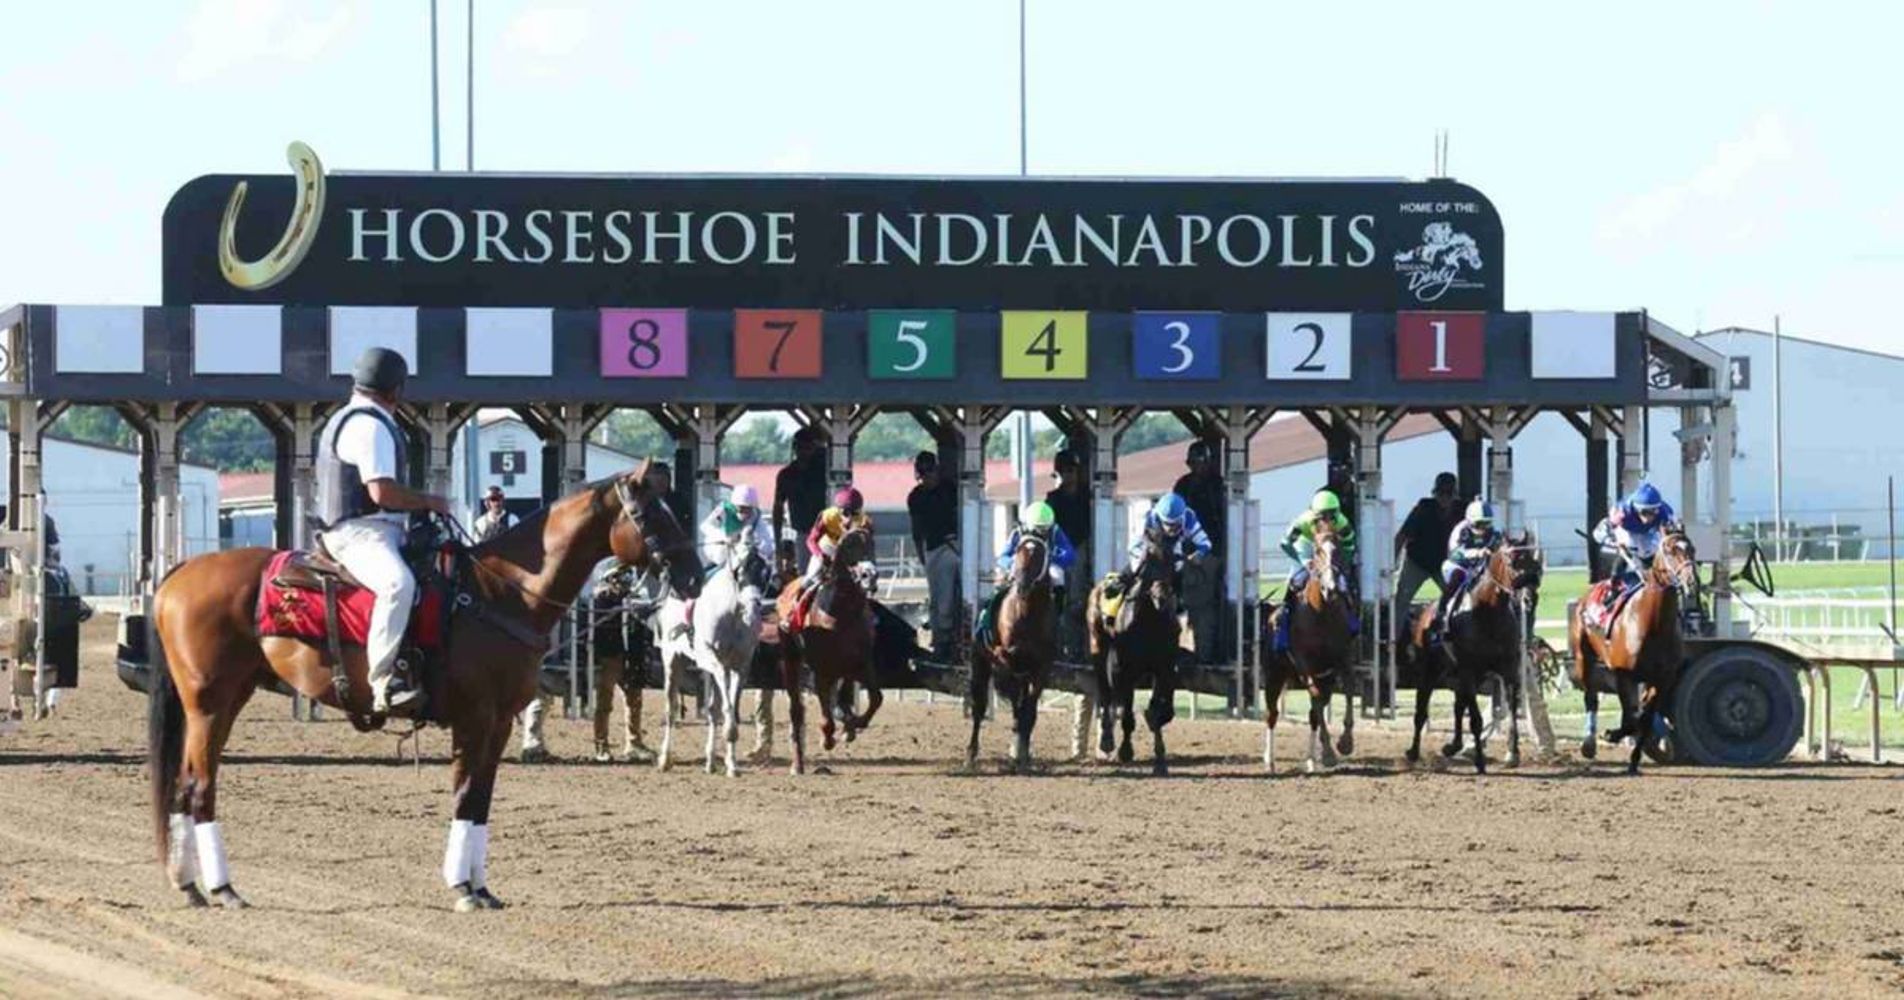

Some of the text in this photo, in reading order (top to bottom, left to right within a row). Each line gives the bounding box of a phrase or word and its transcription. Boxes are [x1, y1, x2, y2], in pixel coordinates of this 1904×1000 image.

[1399, 202, 1433, 214] HOME
[1435, 202, 1451, 214] OF
[347, 208, 1376, 267] HORSESHOE INDIANAPOLIS
[627, 319, 661, 371] 8
[763, 320, 798, 372] 7
[893, 320, 928, 372] 5
[1025, 319, 1062, 372] 4
[1162, 320, 1195, 373] 3
[1292, 321, 1327, 373] 2
[1429, 321, 1452, 373] 1
[502, 453, 514, 472] 5
